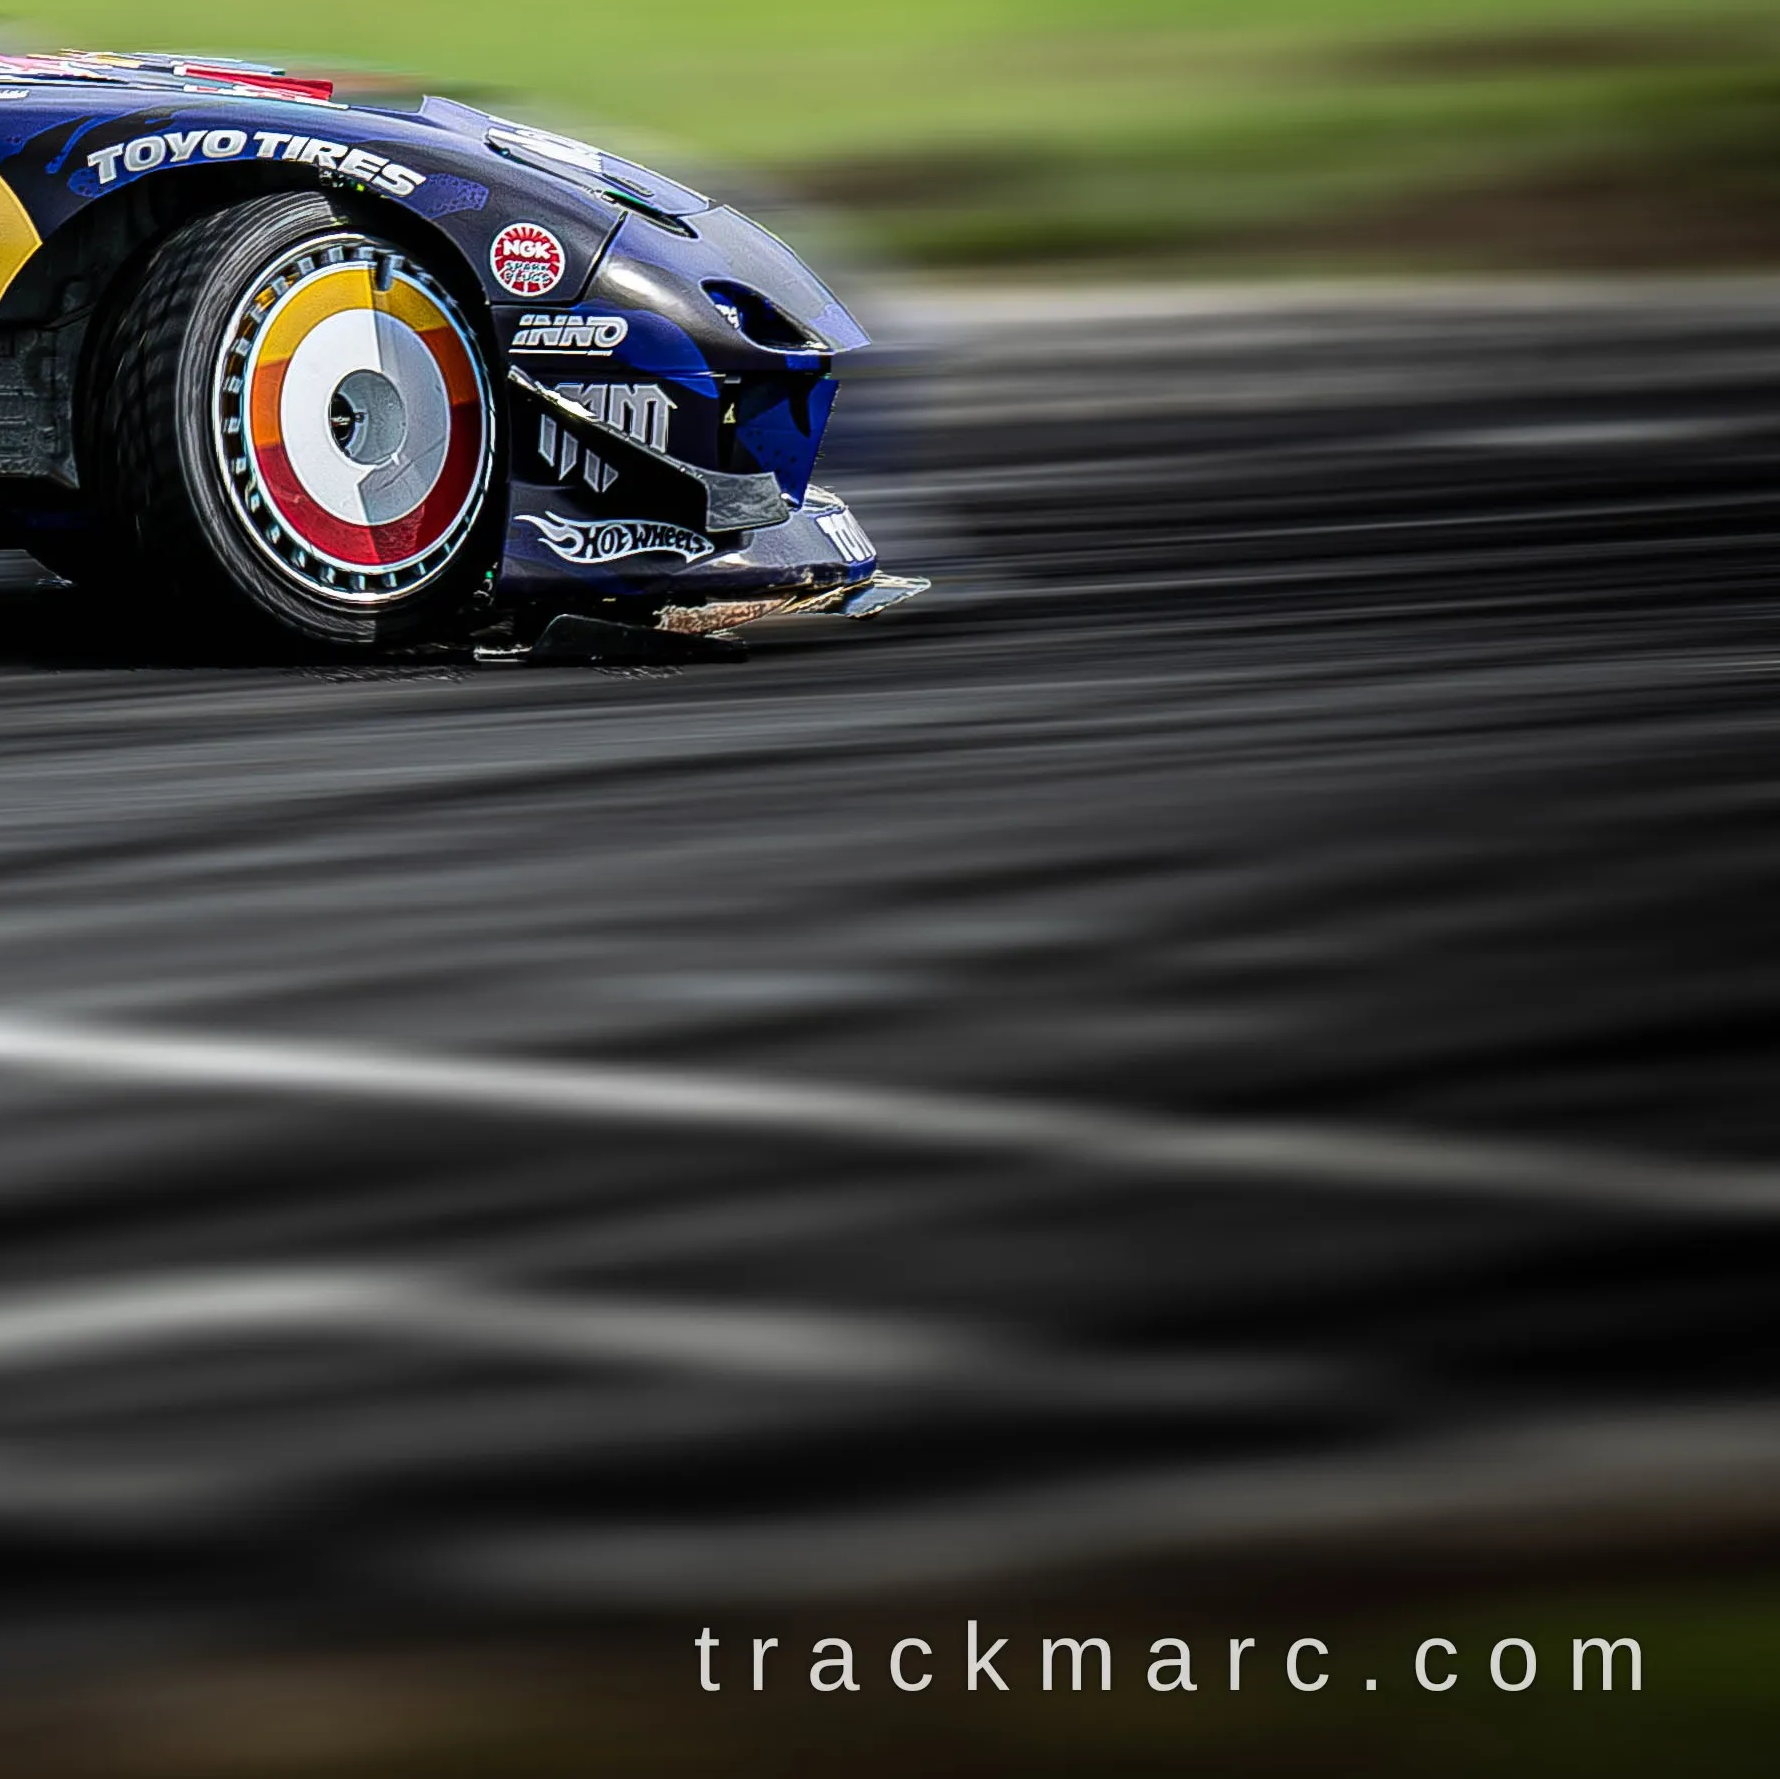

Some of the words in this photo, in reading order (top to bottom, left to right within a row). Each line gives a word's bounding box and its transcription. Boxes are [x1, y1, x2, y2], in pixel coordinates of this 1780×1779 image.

[87, 129, 248, 185] TOYO
[253, 131, 427, 197] TIRES
[503, 239, 551, 260] NGK
[511, 314, 629, 348] INNO
